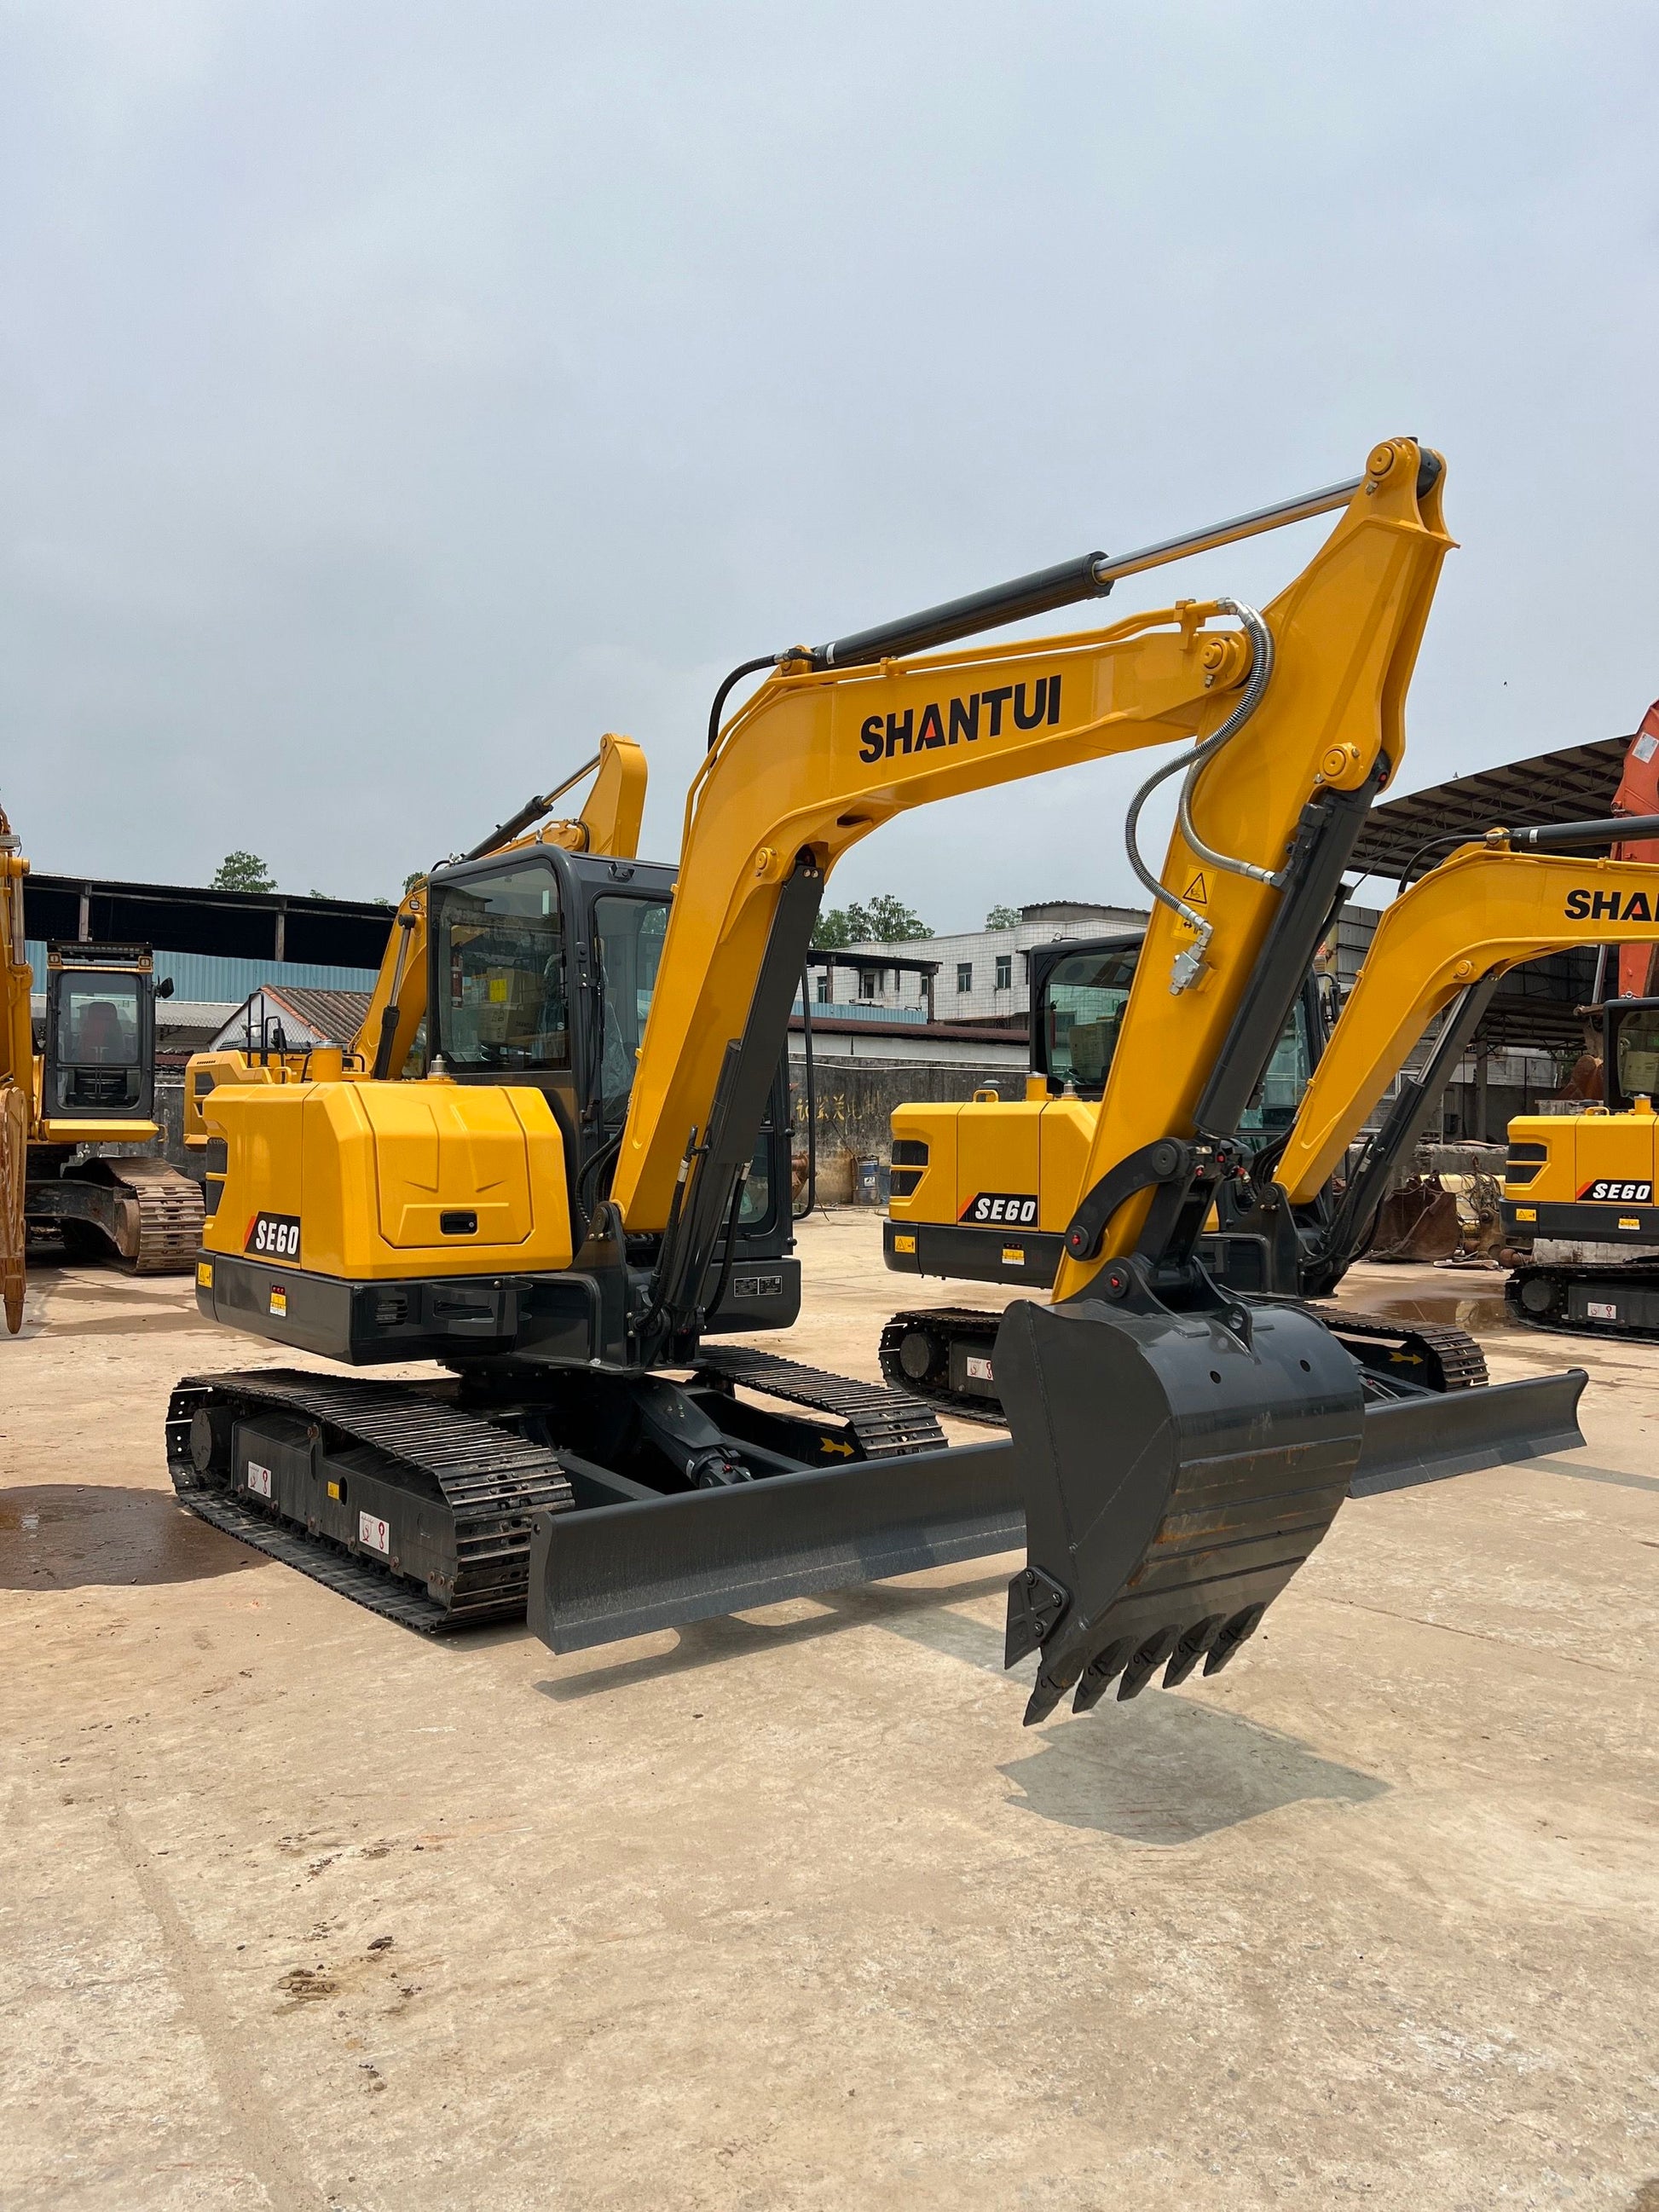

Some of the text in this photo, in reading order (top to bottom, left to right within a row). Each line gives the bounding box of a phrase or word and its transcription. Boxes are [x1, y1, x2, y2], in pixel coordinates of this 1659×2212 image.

[858, 674, 1061, 763] SHANTUI
[1564, 889, 1659, 922] SHA
[1592, 1183, 1650, 1200] SE60
[974, 1198, 1036, 1222] SE60
[256, 1219, 299, 1255] SE60
